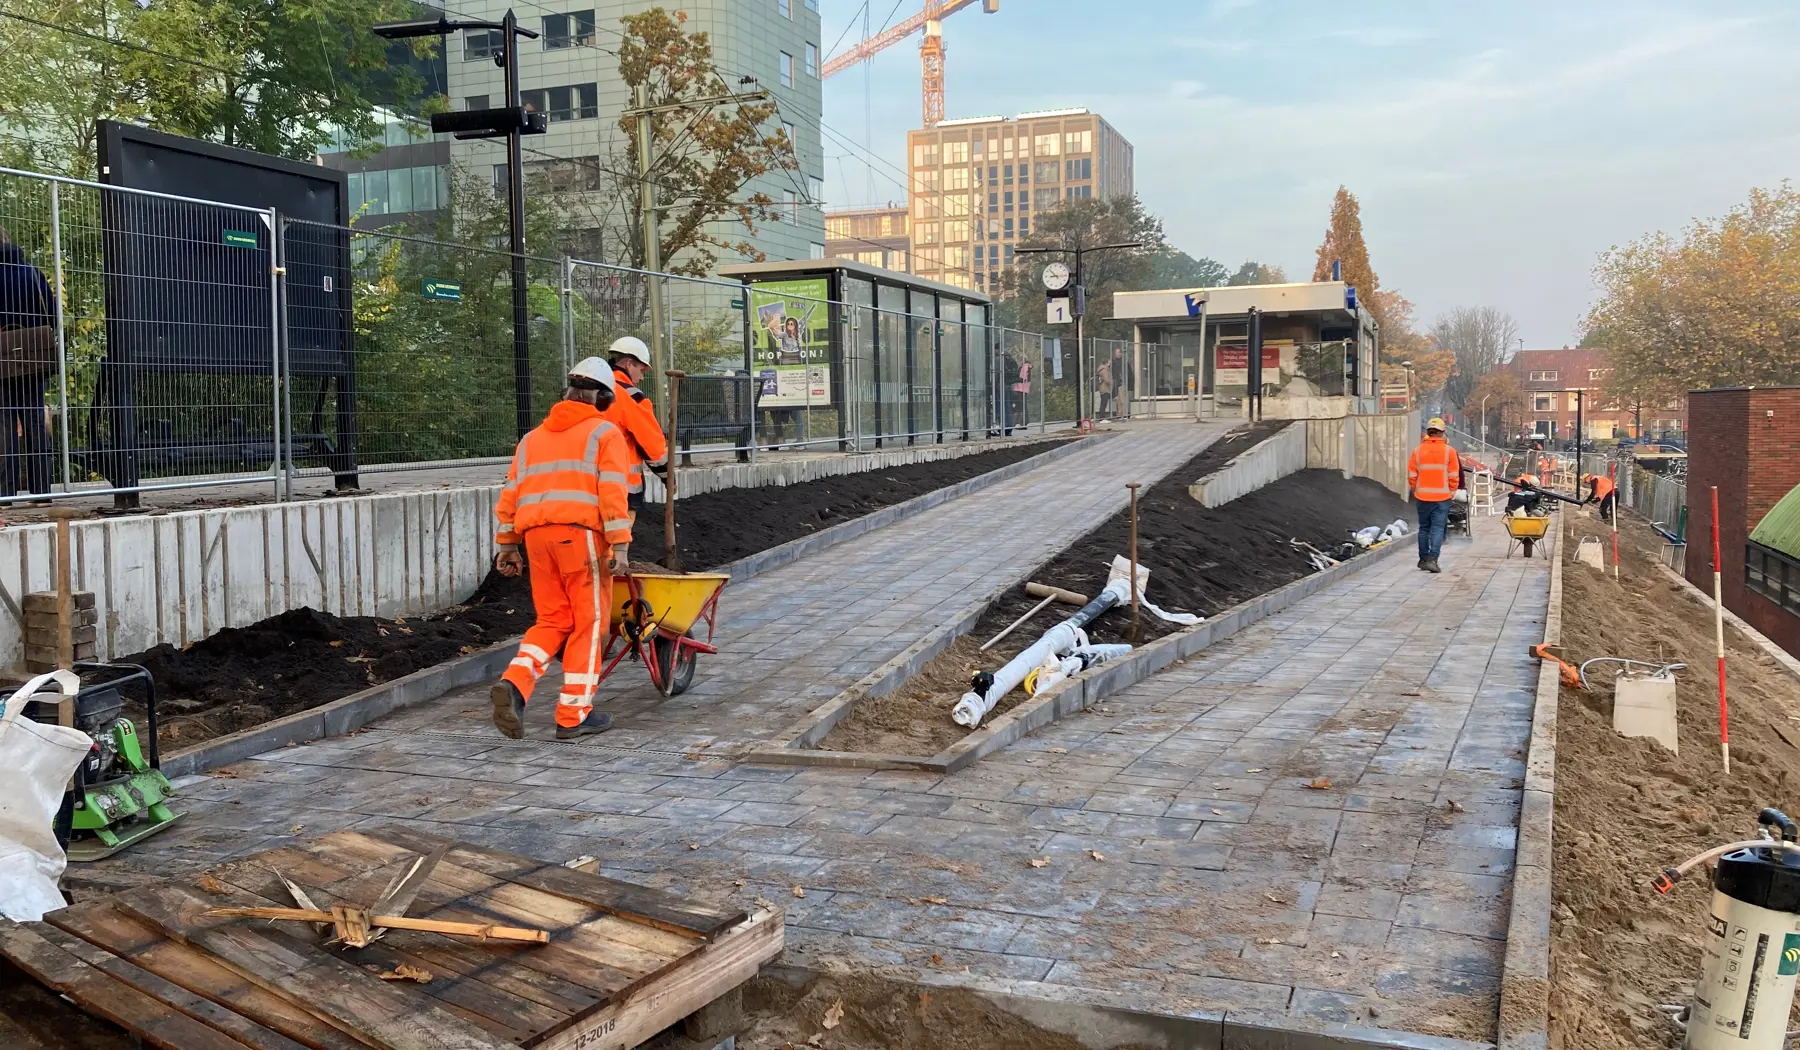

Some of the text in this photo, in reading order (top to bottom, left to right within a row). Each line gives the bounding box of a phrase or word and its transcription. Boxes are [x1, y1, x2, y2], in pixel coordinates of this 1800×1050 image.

[1056, 307, 1062, 321] 1
[758, 349, 823, 360] HOP ON!
[573, 1018, 616, 1050] 12-2018
